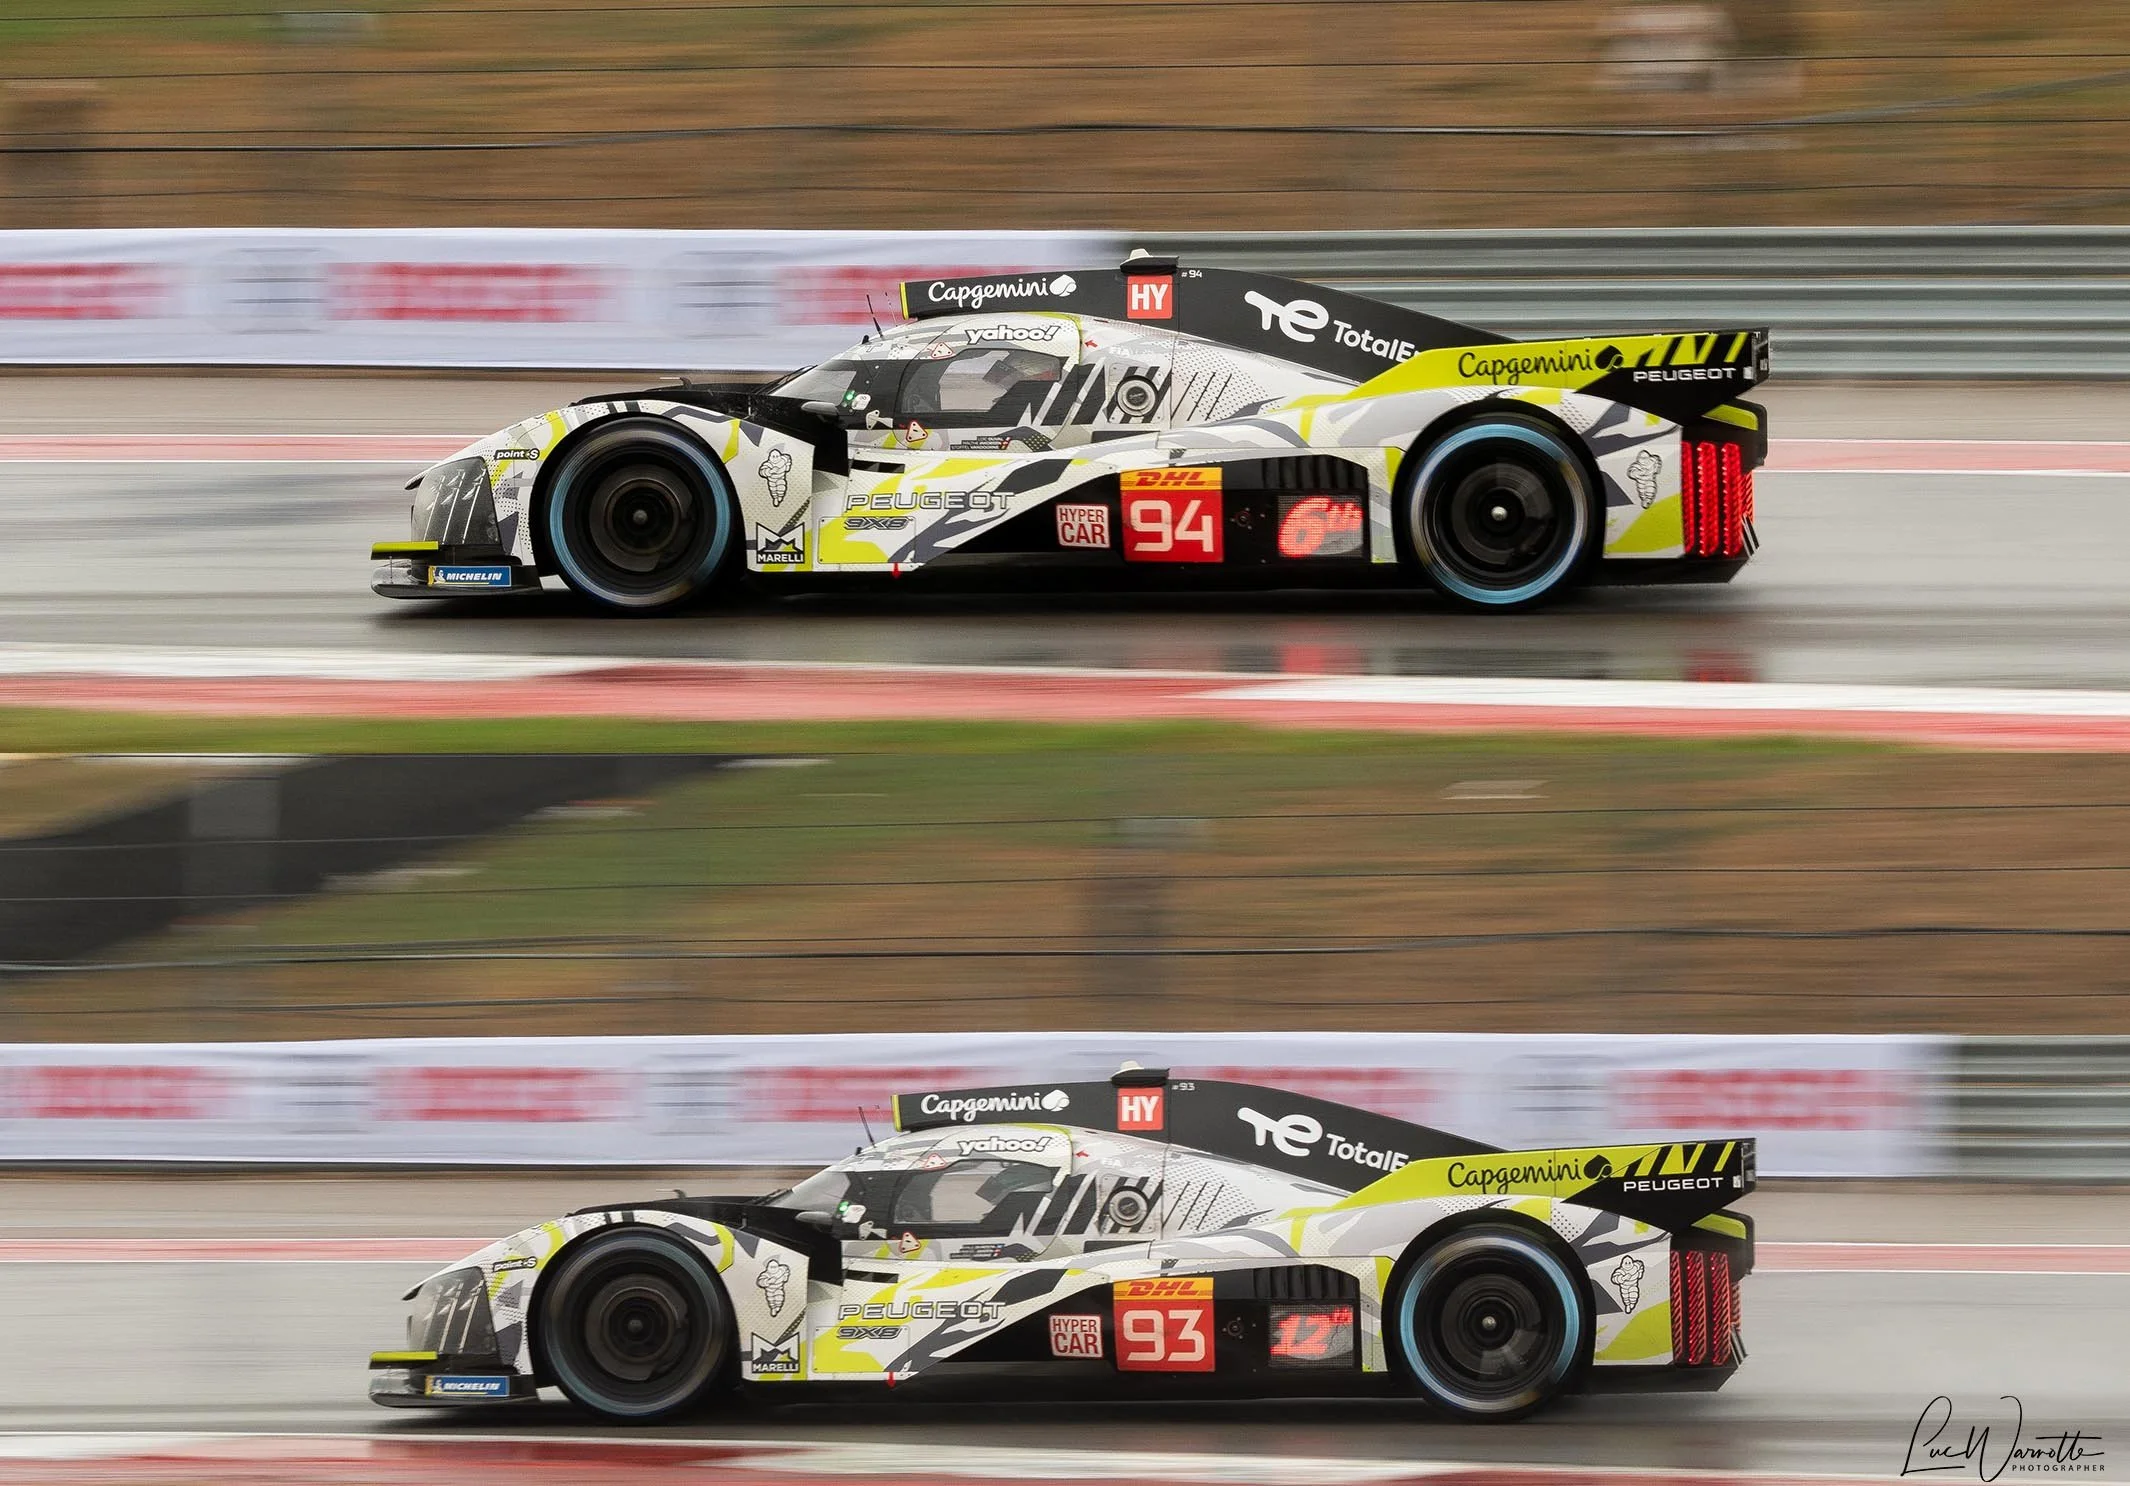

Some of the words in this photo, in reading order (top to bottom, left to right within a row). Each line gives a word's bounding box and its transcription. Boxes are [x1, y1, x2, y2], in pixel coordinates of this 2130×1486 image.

[928, 278, 1047, 309] Capgemini
[1131, 283, 1168, 310] HY
[964, 325, 1059, 344] yahoo!
[1334, 319, 1421, 364] TotalE
[1458, 350, 1592, 385] Capgemini
[1633, 367, 1736, 382] PEUGEOT
[496, 450, 525, 459] point
[1135, 472, 1203, 486] DHL
[846, 491, 1014, 513] PEUGEOT
[844, 517, 909, 530] 9X8
[1059, 508, 1105, 522] HYPER
[1060, 523, 1106, 545] CAR
[1130, 500, 1214, 552] 94
[757, 553, 804, 562] MARELLI
[446, 572, 502, 581] MICHELIN
[921, 1092, 1041, 1121] Capgemini
[1121, 1096, 1159, 1122] HY
[958, 1136, 1050, 1156] yahoo!
[1326, 1133, 1412, 1173] TotalE
[1448, 1159, 1581, 1194] Capgemini
[1624, 1177, 1723, 1192] PEUGEOT
[1128, 1281, 1200, 1296] DHL
[838, 1301, 1006, 1321] PEUGEOT
[837, 1326, 902, 1340] 9X8
[1052, 1318, 1098, 1332] HYPER
[1053, 1332, 1099, 1355] CAR
[1123, 1309, 1206, 1362] 93
[752, 1363, 799, 1372] MARELLI
[443, 1382, 501, 1391] MICHELIN
